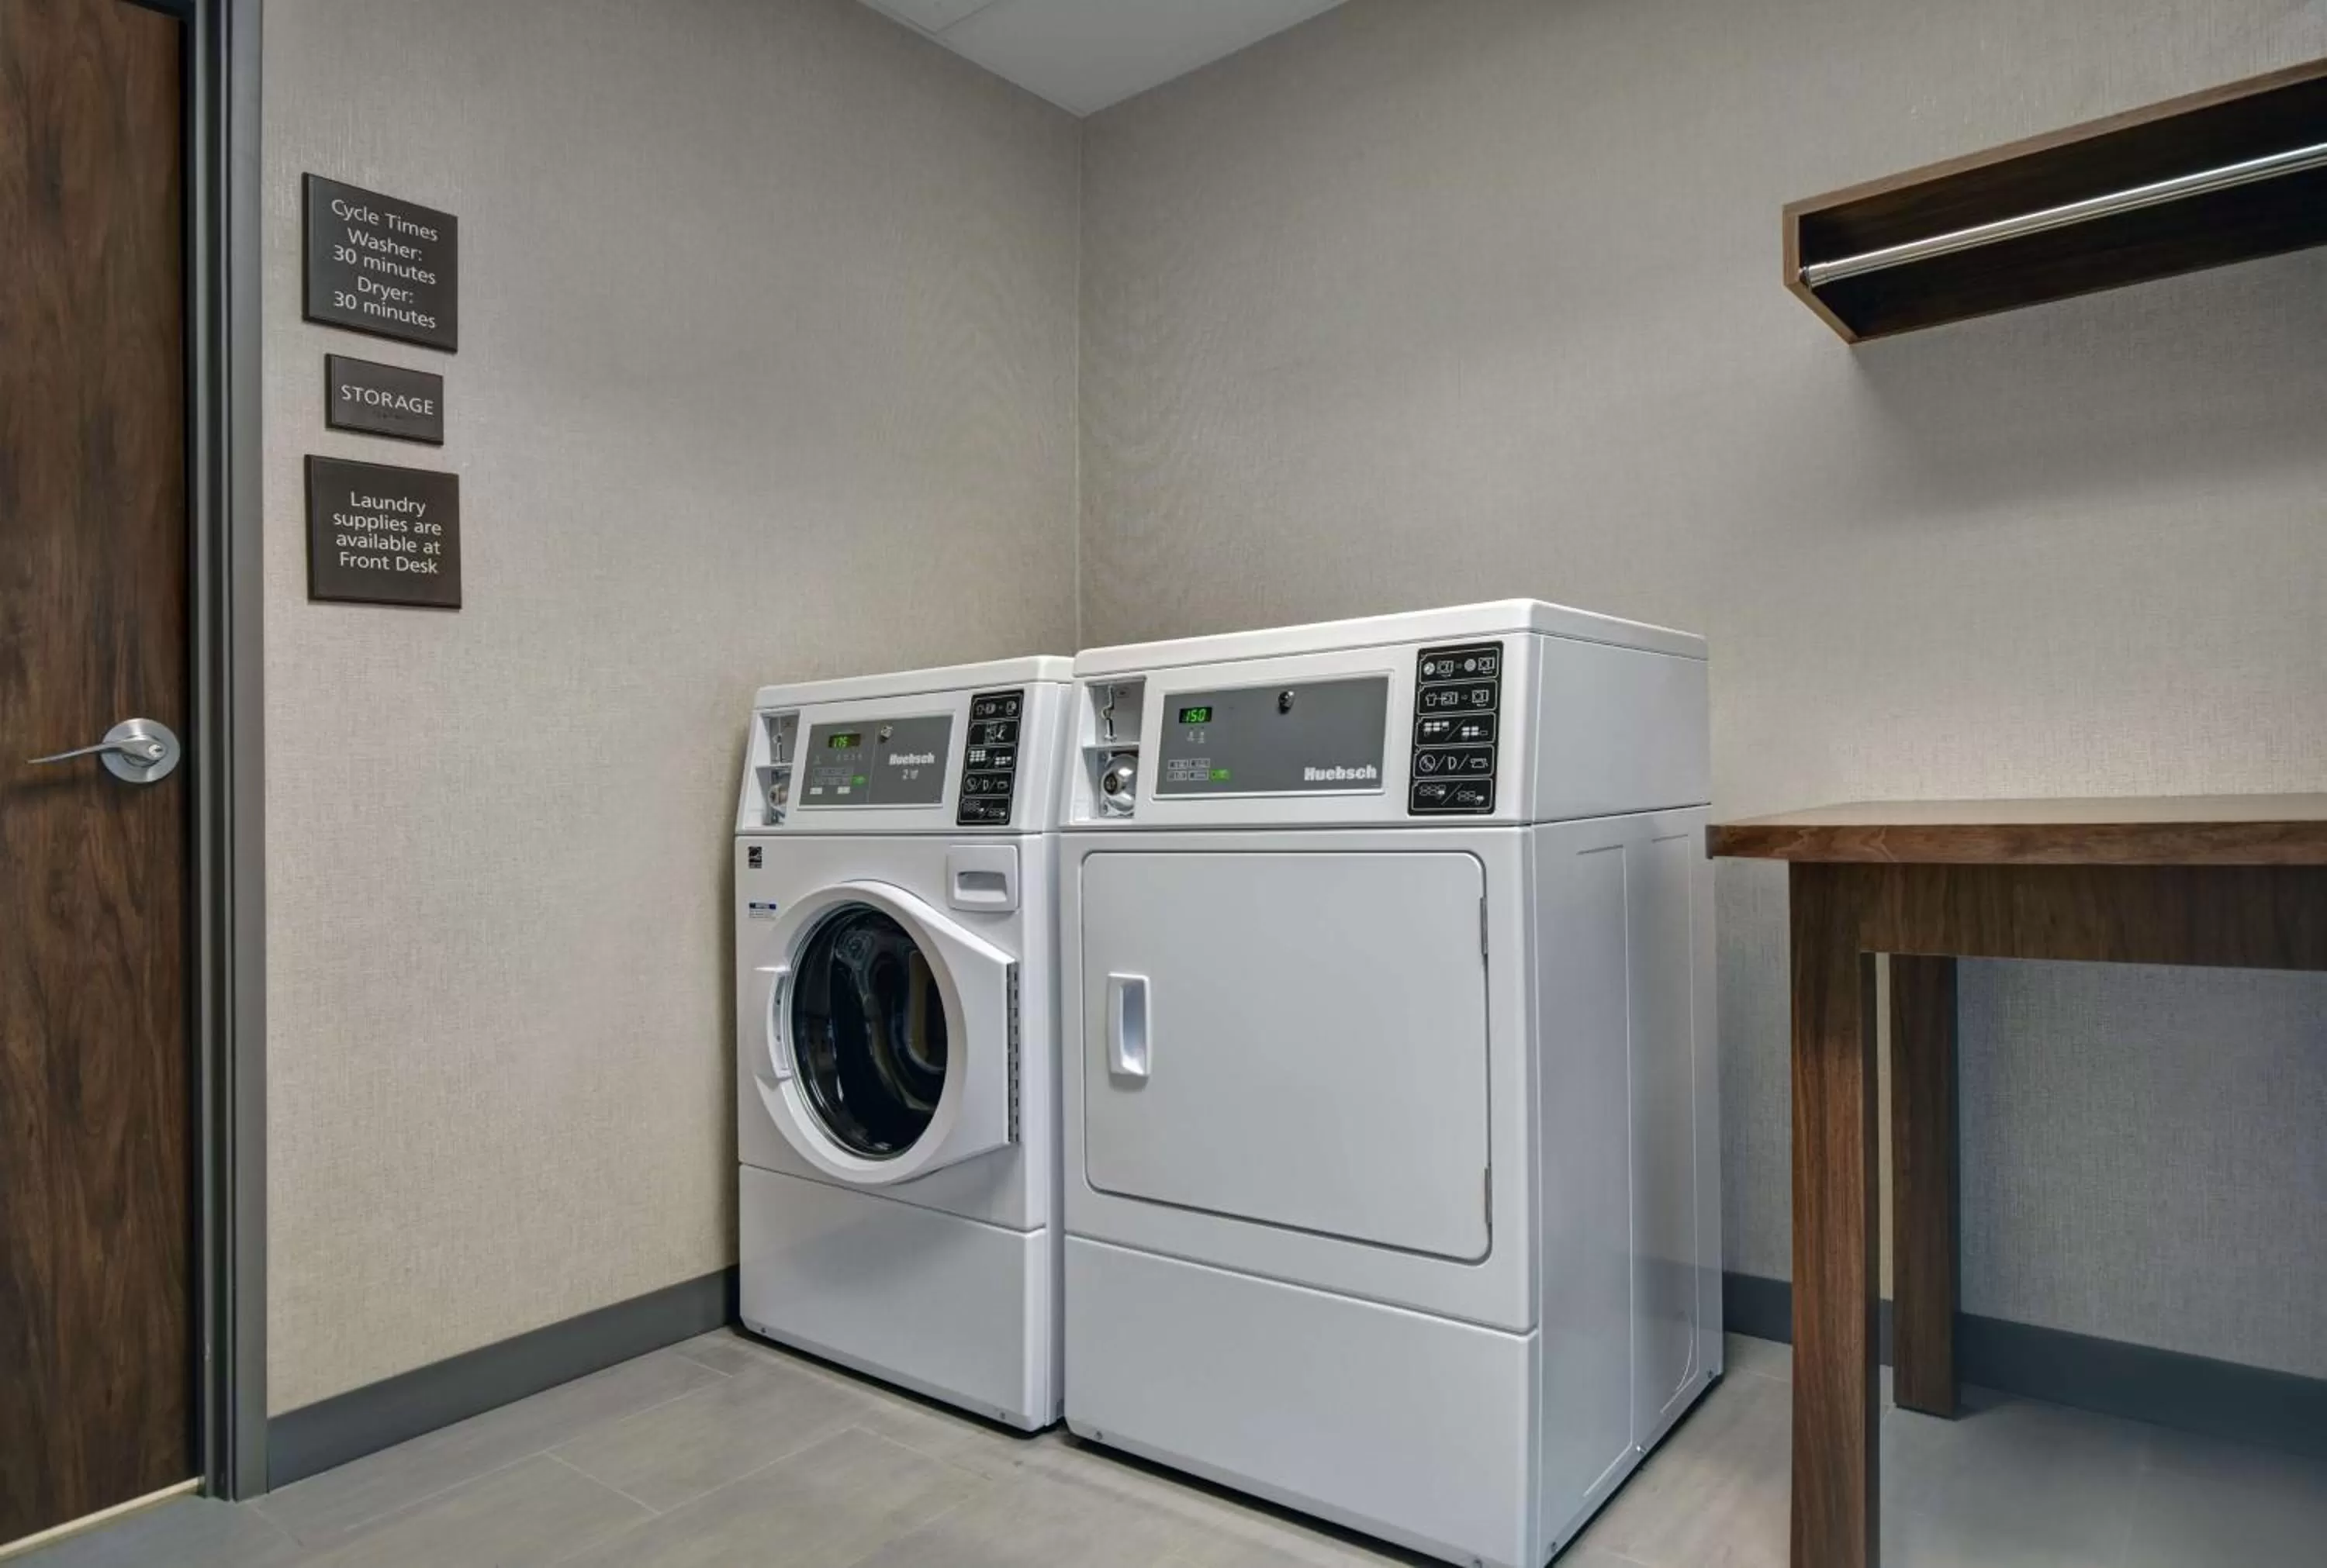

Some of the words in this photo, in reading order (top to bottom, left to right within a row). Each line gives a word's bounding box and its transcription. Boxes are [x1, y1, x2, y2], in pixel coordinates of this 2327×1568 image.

[331, 199, 379, 226] Cycle
[385, 212, 439, 242] Times
[347, 226, 424, 262] Washer:
[332, 244, 358, 264] 30
[363, 254, 437, 285] minutes
[357, 275, 414, 305] Dryer:
[332, 290, 358, 310] 30
[363, 300, 437, 330] minutes
[341, 384, 434, 416] STORAGE
[350, 490, 427, 518] Laundry
[332, 512, 409, 534] supplies
[413, 521, 443, 536] are
[335, 532, 418, 554] available
[423, 540, 441, 556] at
[339, 551, 390, 571] Front
[396, 555, 439, 575] Desk
[1304, 764, 1378, 782] Huebsch
